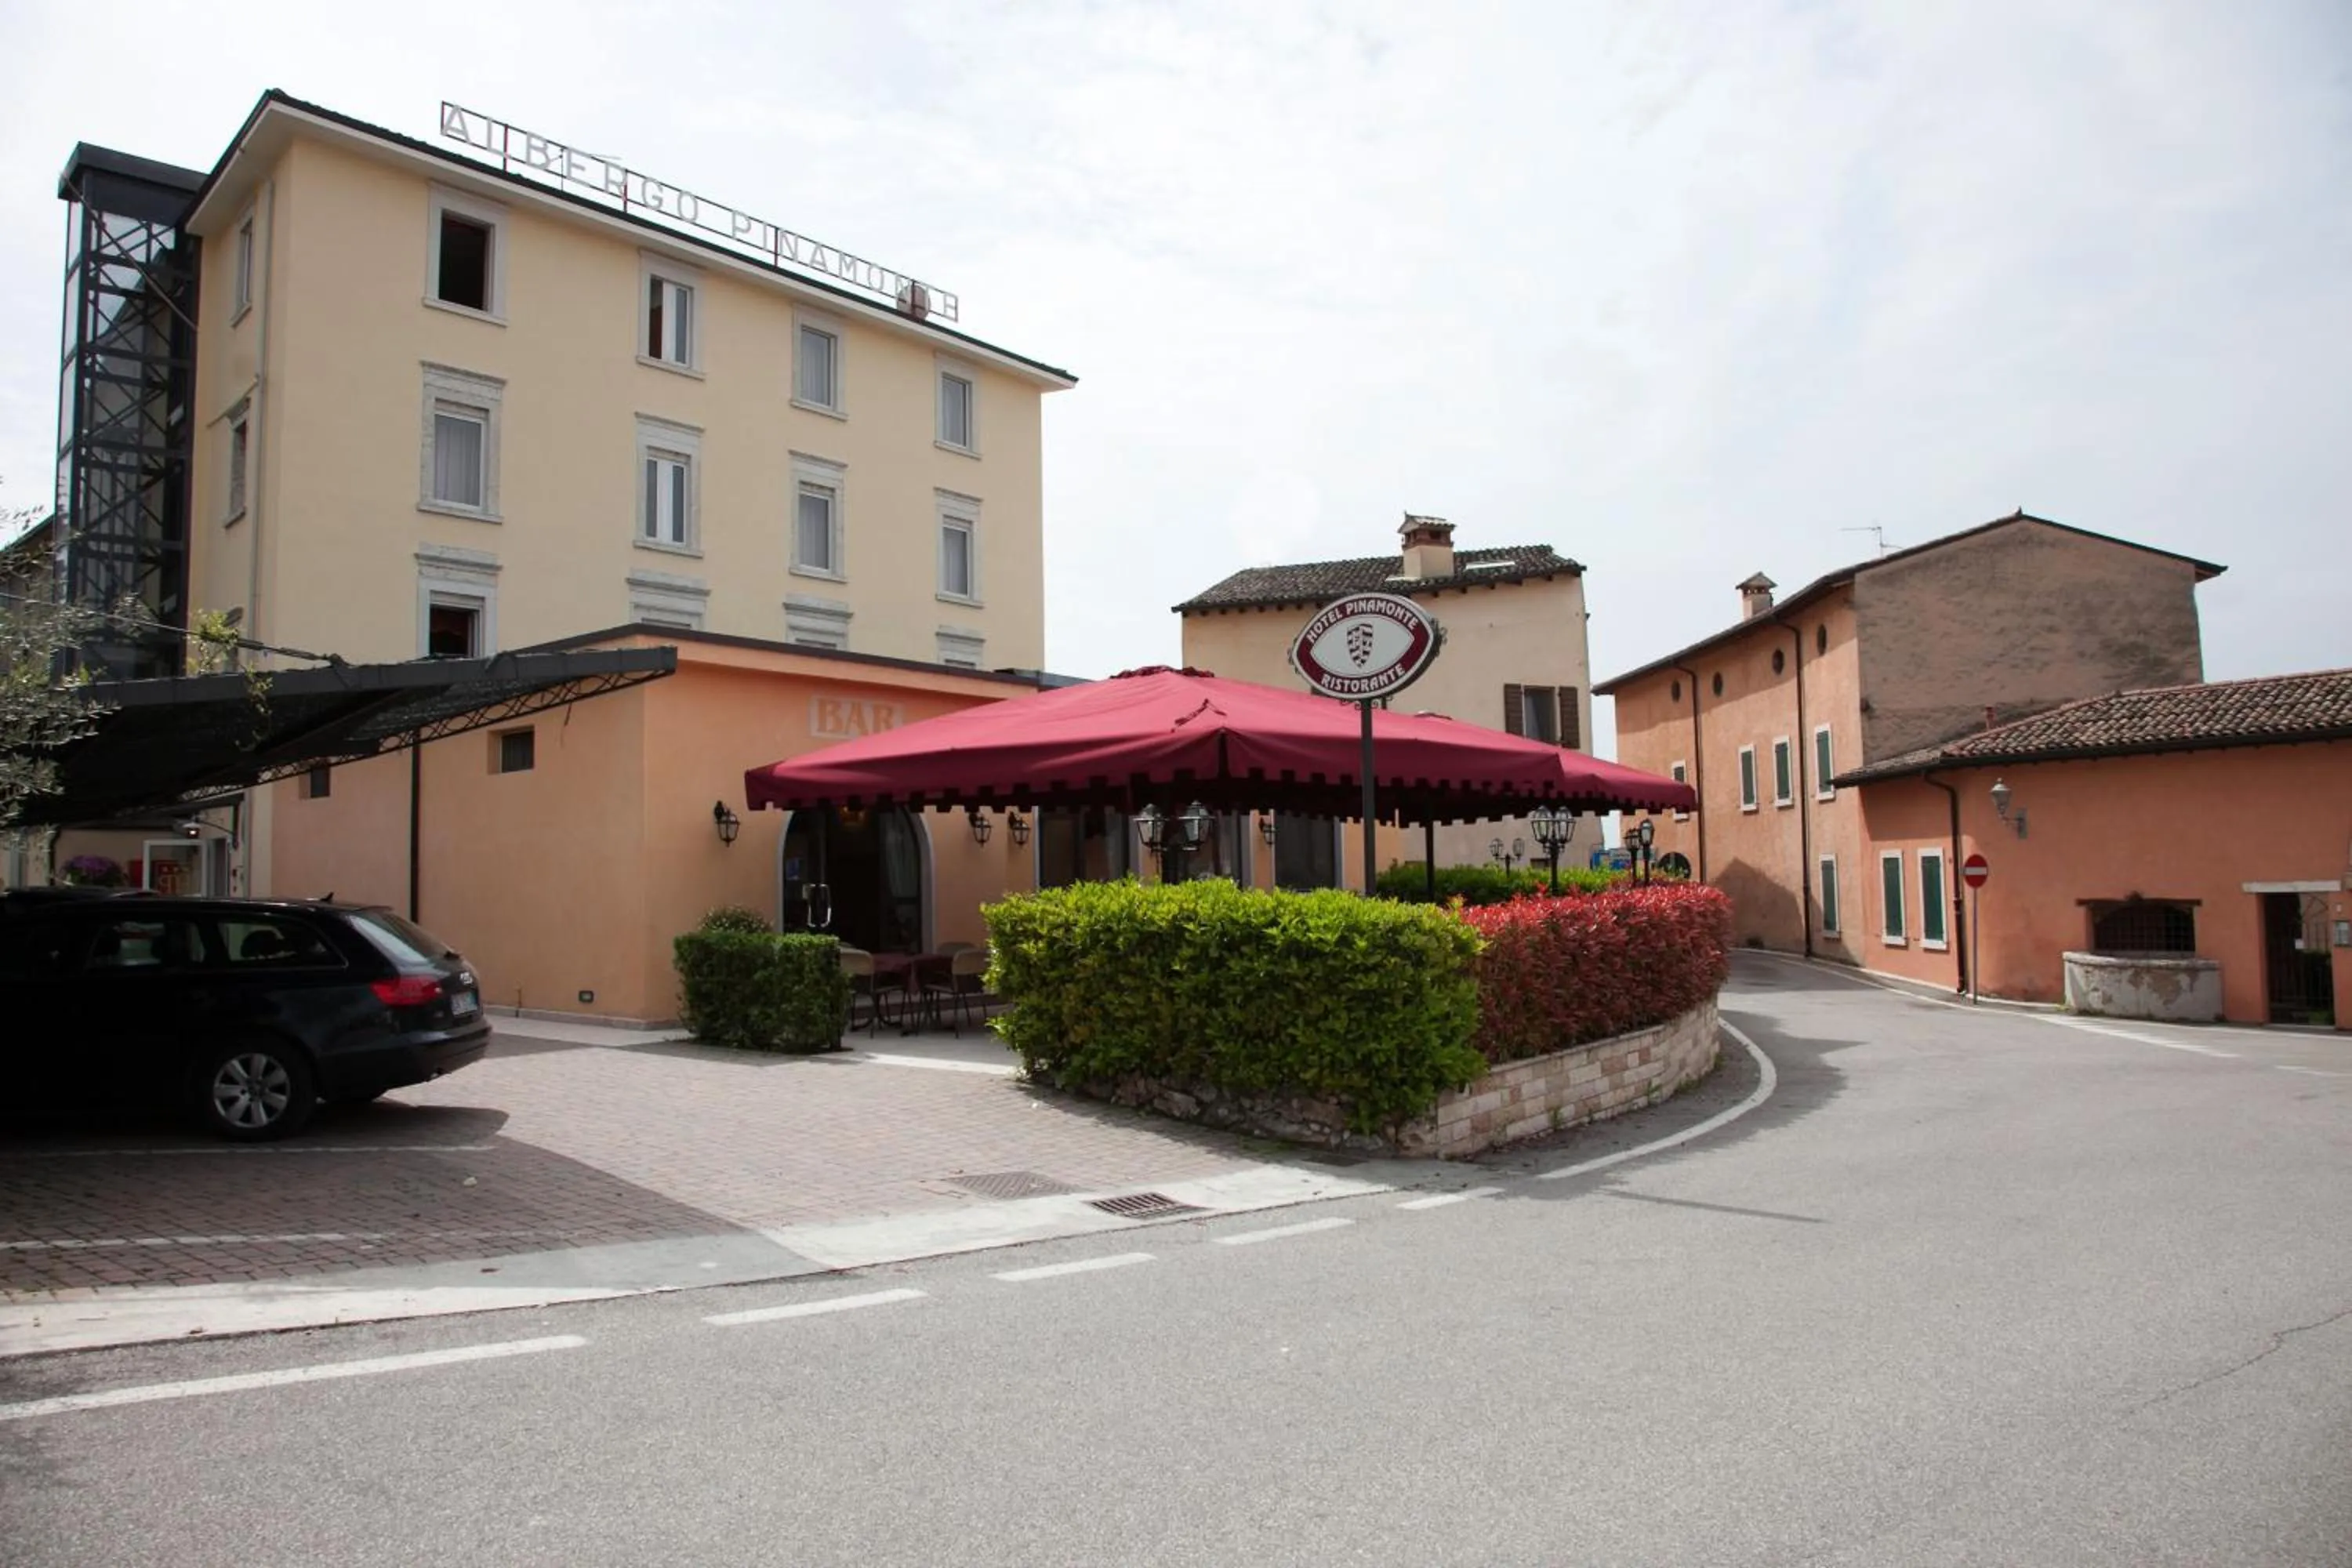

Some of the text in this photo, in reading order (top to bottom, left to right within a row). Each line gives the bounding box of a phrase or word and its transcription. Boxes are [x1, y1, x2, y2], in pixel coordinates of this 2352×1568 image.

[441, 104, 699, 223] ALBERGO
[1306, 599, 1418, 643] HOTEL PINAMONTE
[1321, 662, 1405, 692] RISTORANTE
[816, 699, 895, 735] BAR
